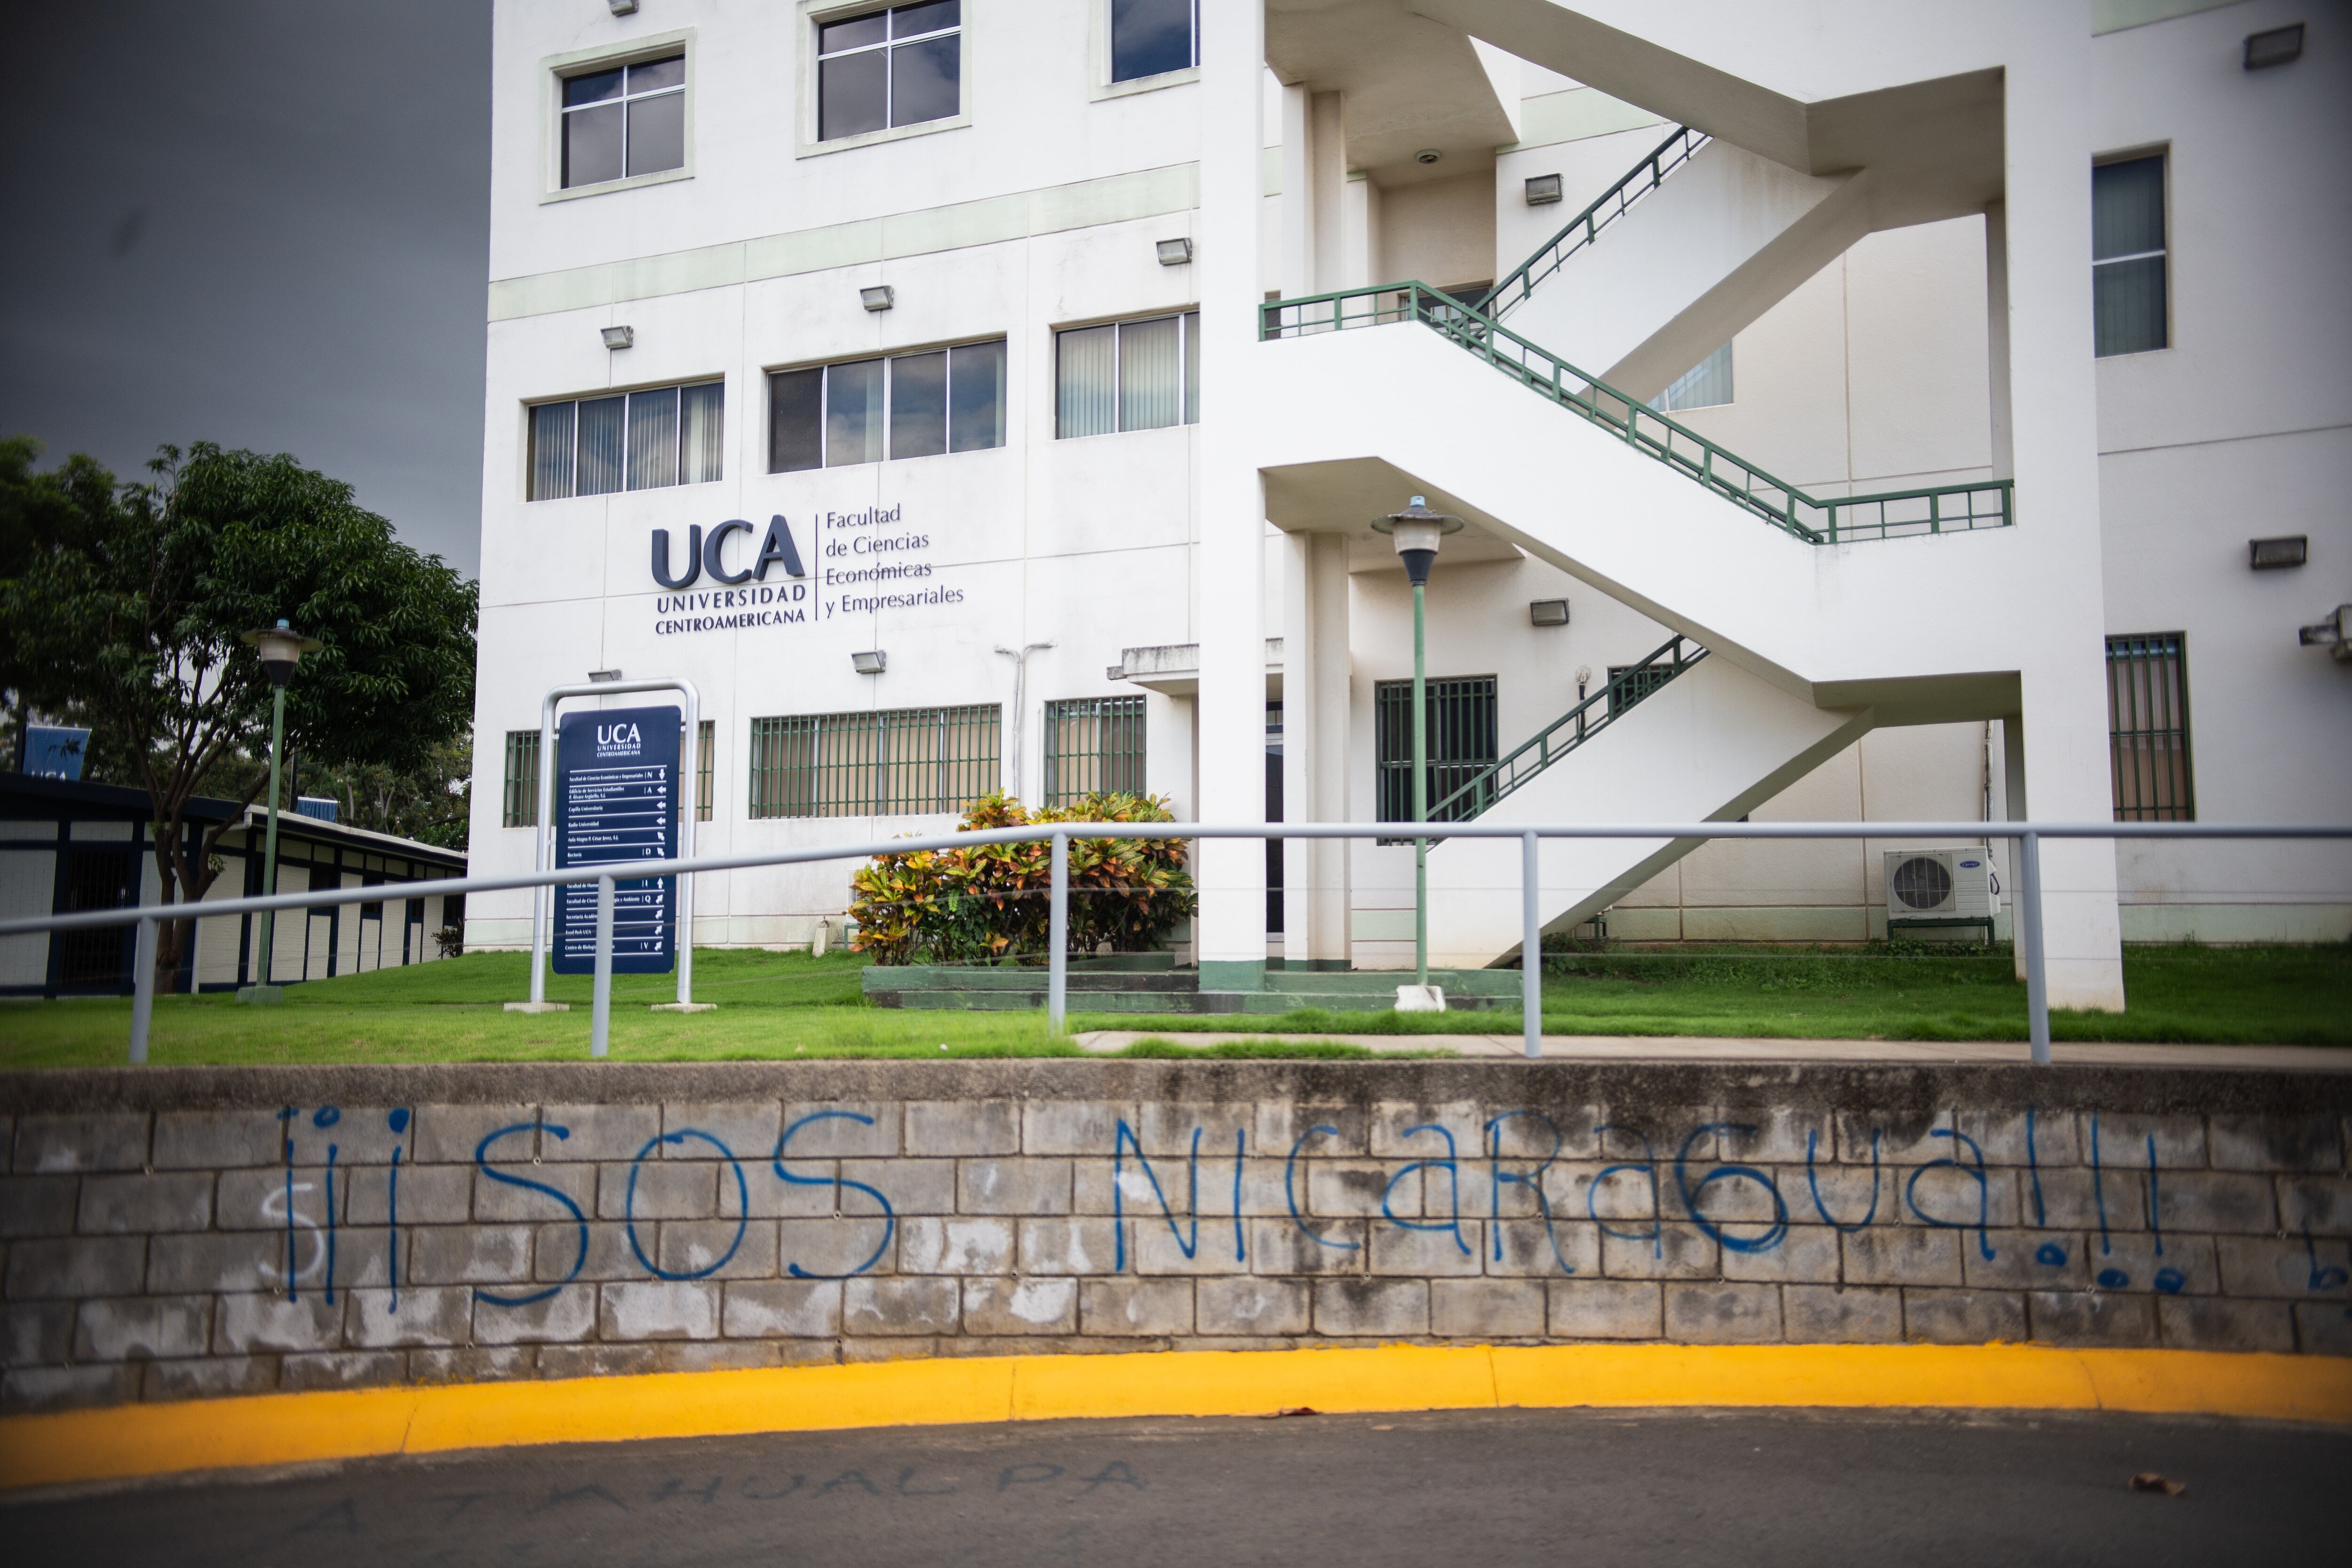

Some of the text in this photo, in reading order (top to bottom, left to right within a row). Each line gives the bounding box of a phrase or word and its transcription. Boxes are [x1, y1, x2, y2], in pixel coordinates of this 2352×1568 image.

[827, 502, 900, 528] Facultad
[652, 514, 806, 589] UCA
[826, 532, 929, 557] de Ciencias
[826, 562, 932, 585] Económicas
[657, 584, 806, 613] UNIVERSIDAD
[826, 584, 964, 619] y Empresariales
[655, 608, 805, 635] CENTROAMERICANA
[597, 722, 641, 745] UCA
[597, 743, 641, 751] UNIVERSIDAD
[645, 895, 651, 903] Q
